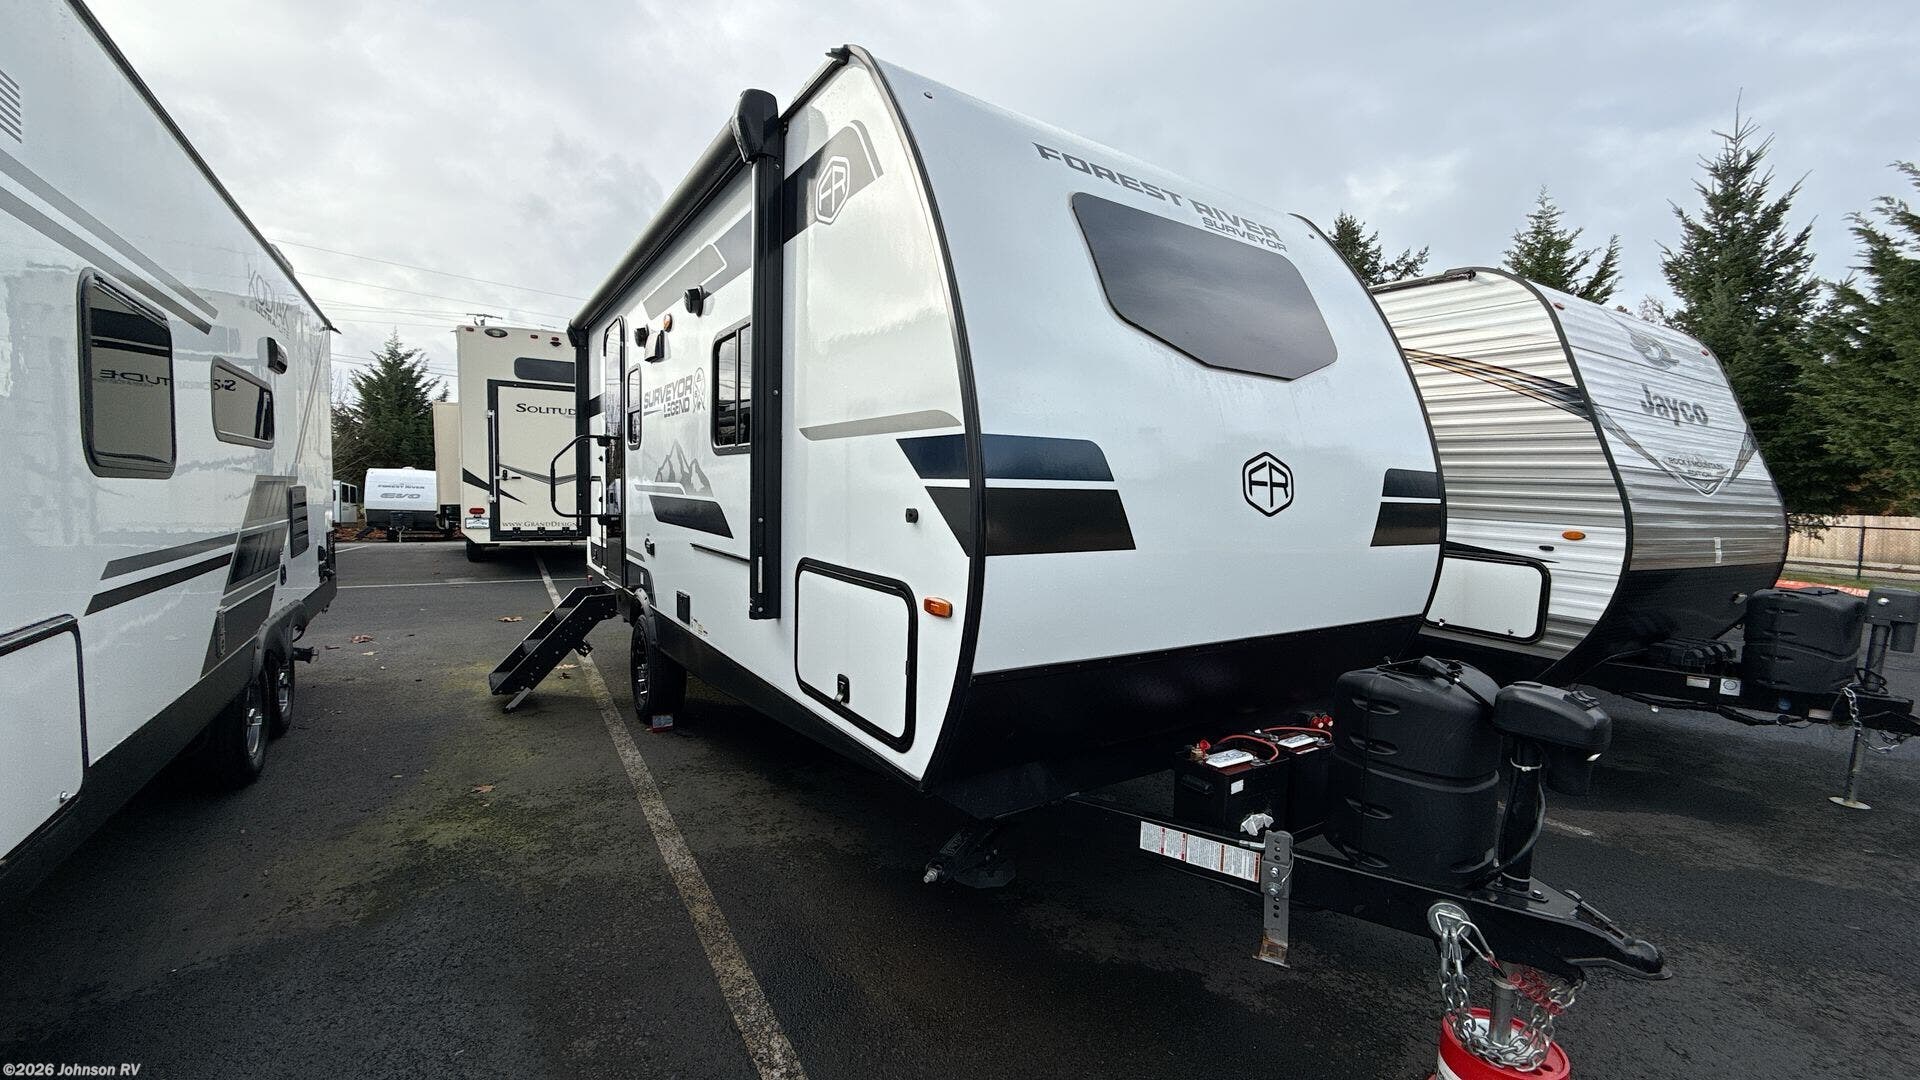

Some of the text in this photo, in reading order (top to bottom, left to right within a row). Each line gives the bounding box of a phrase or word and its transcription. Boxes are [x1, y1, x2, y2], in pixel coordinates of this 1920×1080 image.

[1031, 141, 1282, 241] FOREST RIVER
[1201, 216, 1288, 252] SURVEYOR
[643, 374, 693, 410] SURVEYOR
[663, 397, 690, 418] LEGEND
[1640, 383, 1709, 426] Jayco
